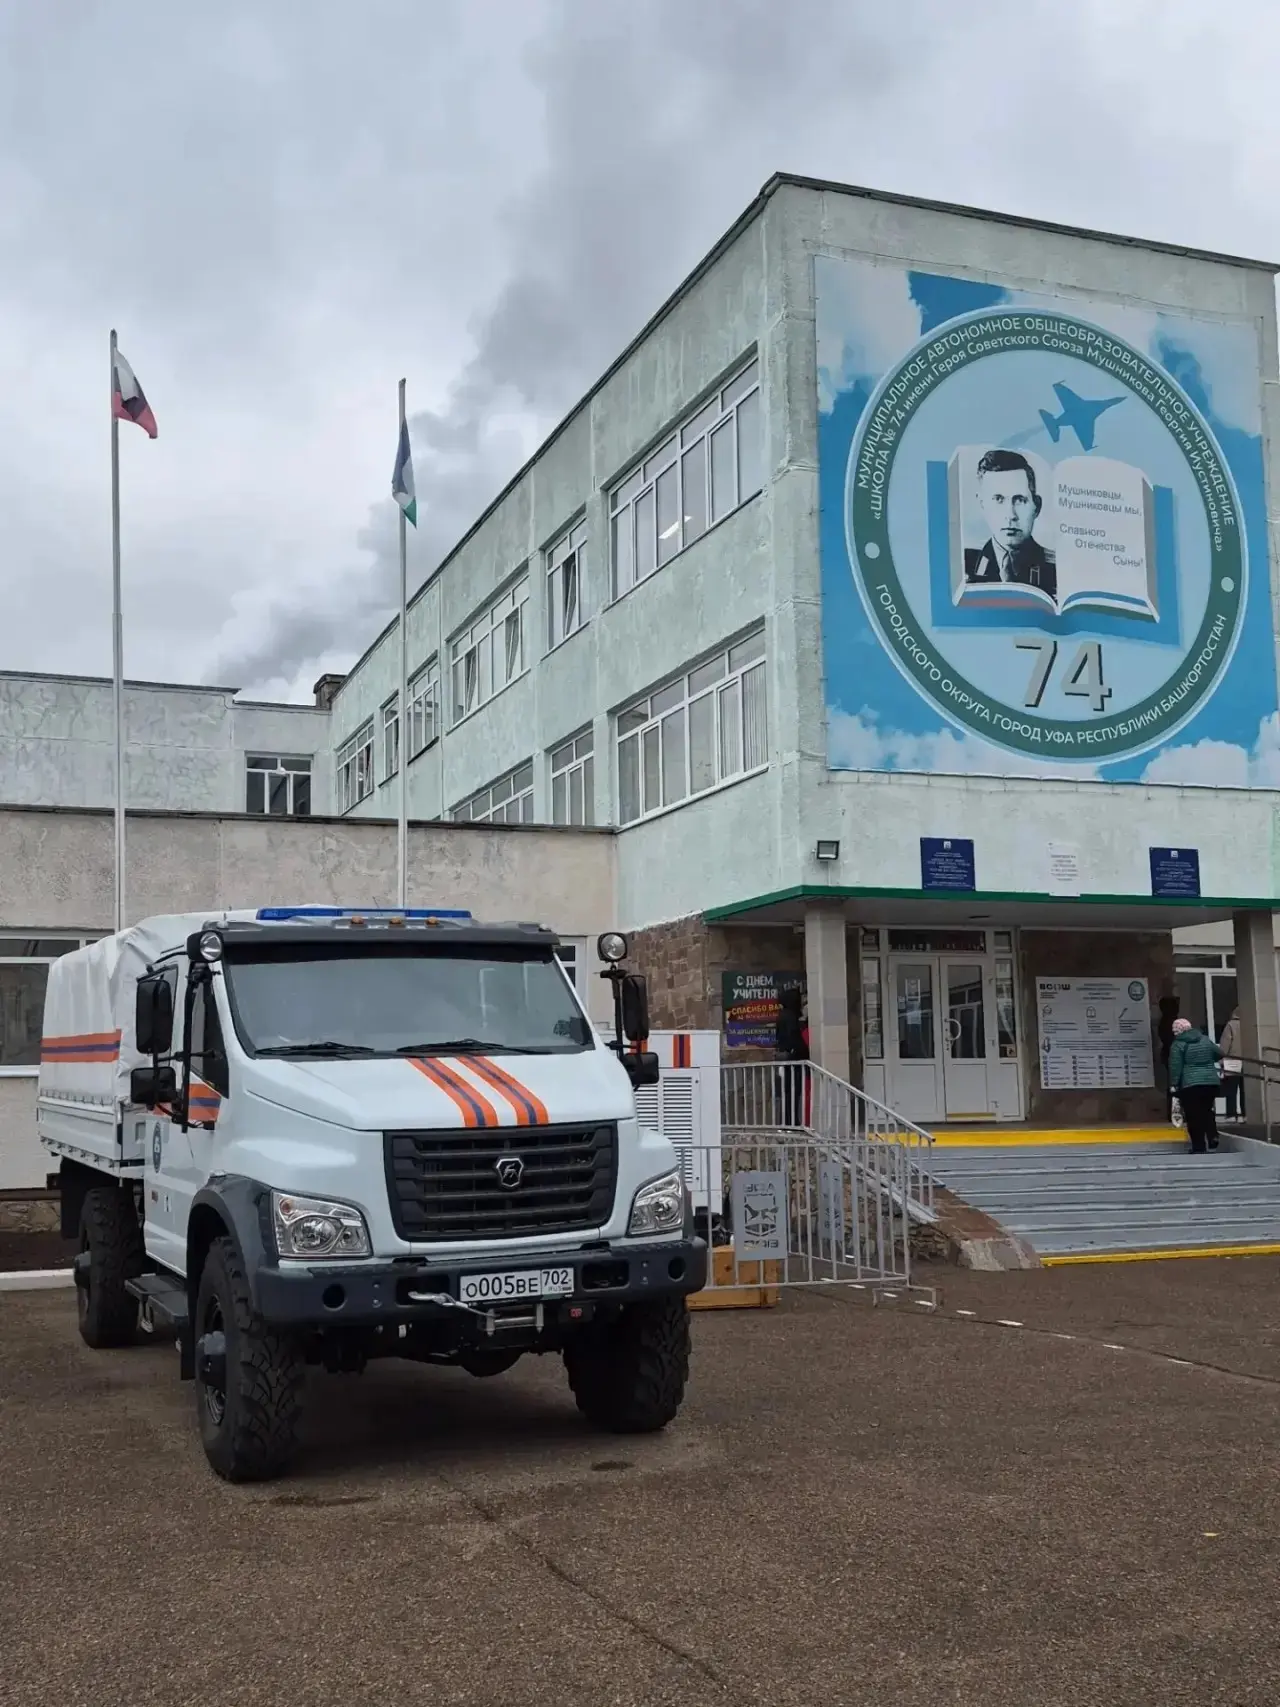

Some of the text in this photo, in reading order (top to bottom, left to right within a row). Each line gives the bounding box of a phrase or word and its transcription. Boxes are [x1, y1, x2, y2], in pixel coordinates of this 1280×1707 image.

[858, 316, 1235, 526] МУНИЦИПАЛЬНОЕ АВТОНОМНОЕ ОБЩЕОБРАЗОВАТЕЛЬНОЕ УЧРЕЖДЕНИЕ
[870, 333, 1224, 552] «ШКОЛА № 74 имени Героя Советского Союза Мушникова Георгия Иустиновича»
[1058, 497, 1121, 514] Мушниковцы
[1075, 538, 1126, 553] Отечества
[876, 584, 1227, 744] ГОРОДСКОГО ОКРУГА ГОРОД УФА РЕСПУБЛИКИ БАШКОРТОСТАН
[1012, 635, 1113, 712] 74
[736, 975, 744, 986] С
[732, 988, 779, 1000] УЧИТЕЛЯ
[731, 1005, 767, 1015] СПАСИБО
[466, 1269, 569, 1298] О005ВЕ 702
